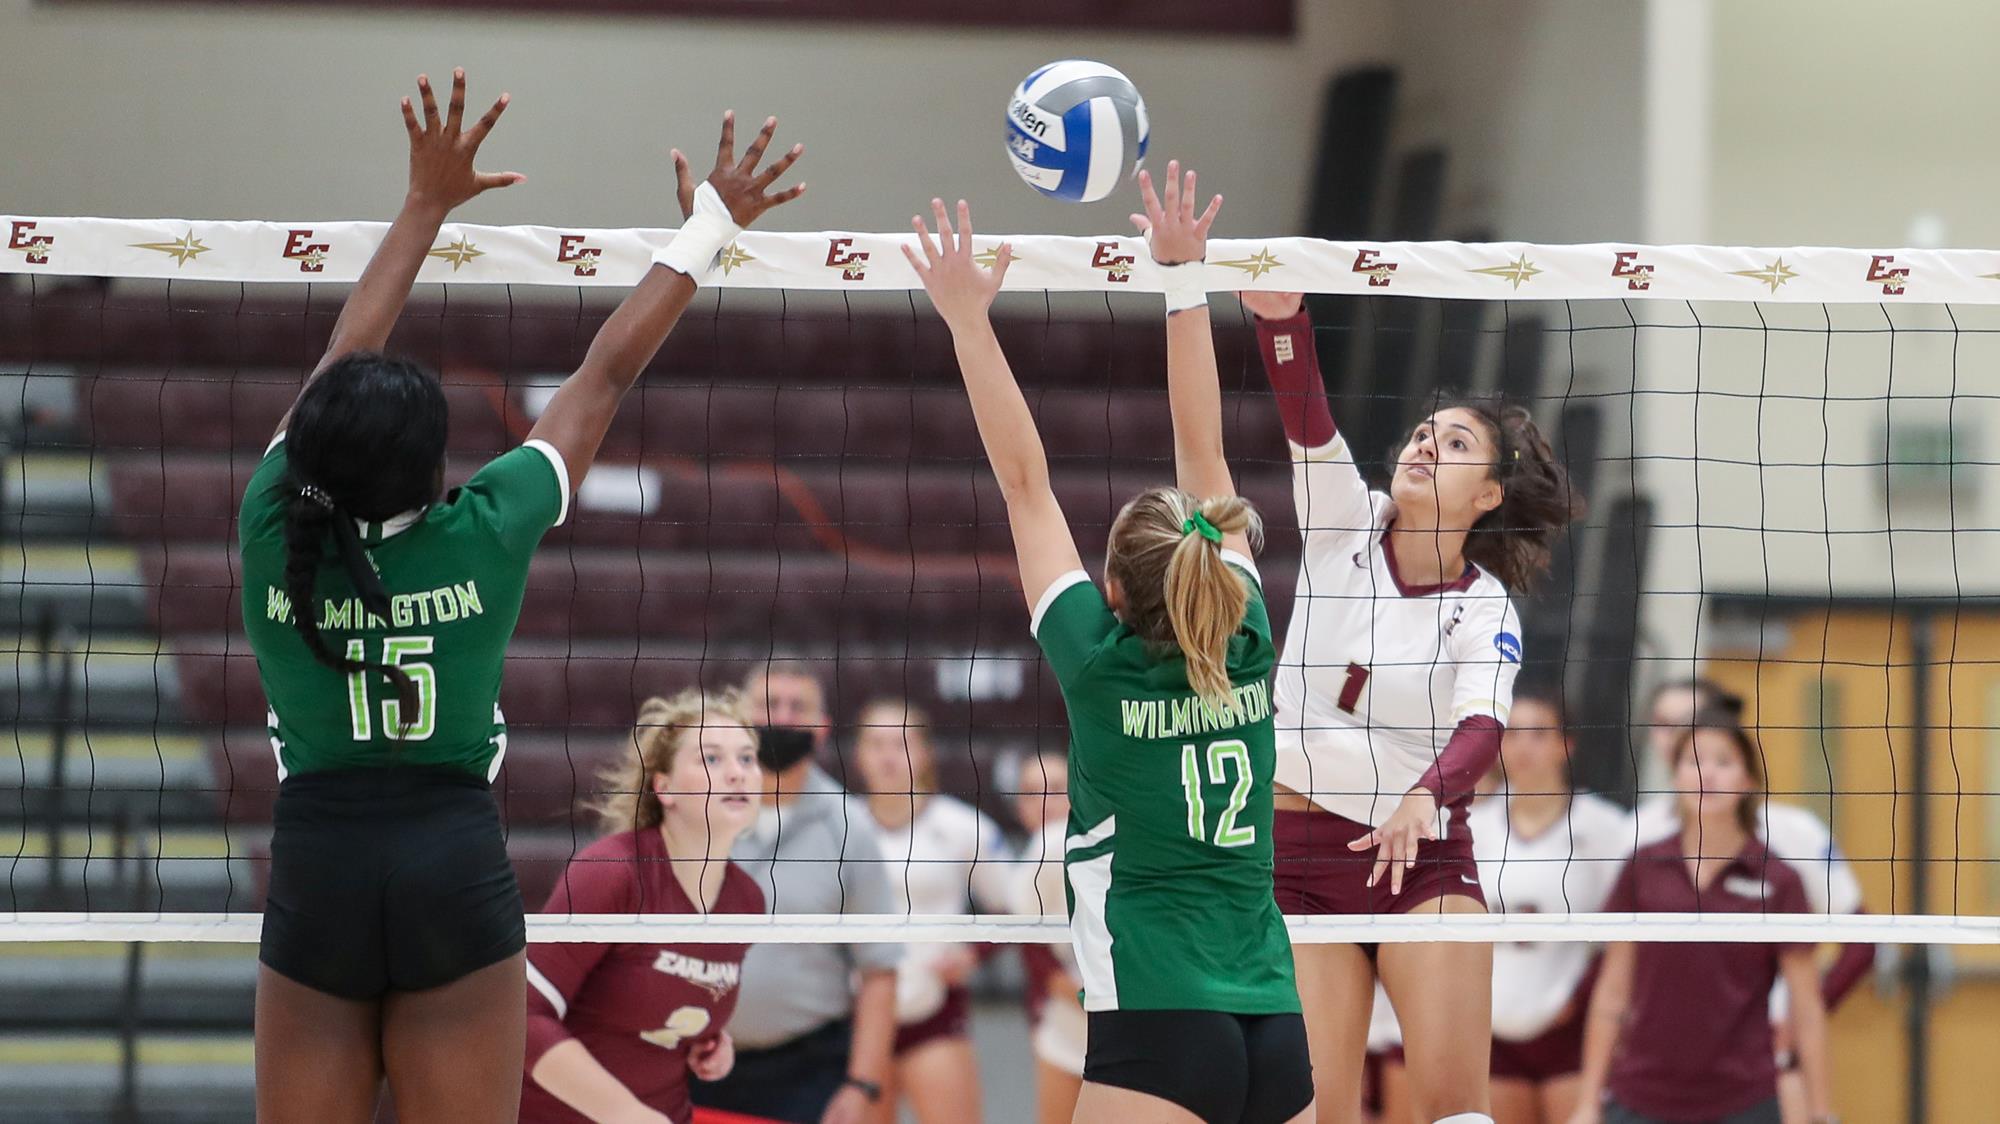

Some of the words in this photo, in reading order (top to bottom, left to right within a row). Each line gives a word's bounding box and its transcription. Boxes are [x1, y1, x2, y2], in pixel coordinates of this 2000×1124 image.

[267, 579, 483, 630] WMIGTON
[346, 635, 437, 741] 15
[1337, 661, 1370, 715] 1
[1181, 739, 1256, 848] 12
